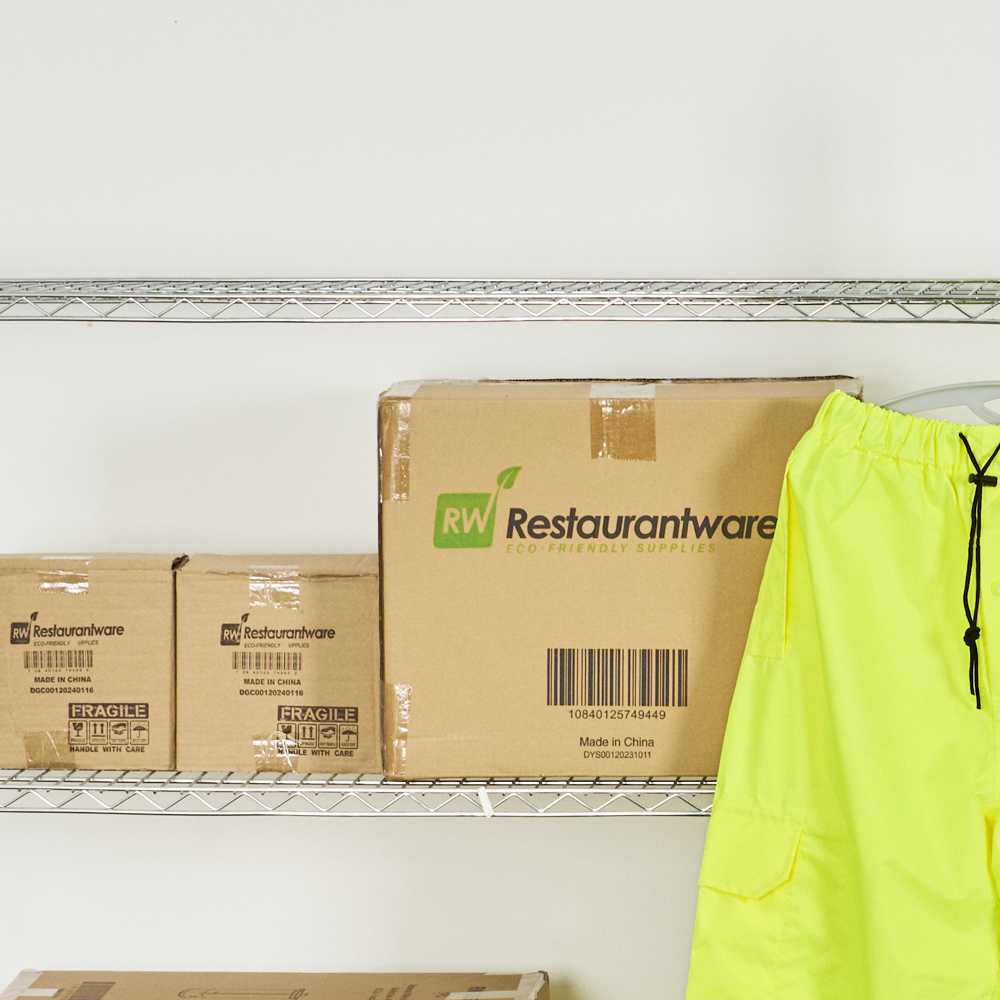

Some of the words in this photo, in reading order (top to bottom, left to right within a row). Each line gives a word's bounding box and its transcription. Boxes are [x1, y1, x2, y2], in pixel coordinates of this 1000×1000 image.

[442, 507, 489, 535] RW
[506, 507, 778, 540] Restaurantware
[637, 543, 716, 553] SUPPLIES
[12, 627, 29, 640] RW
[33, 623, 124, 638] Restaurantware
[223, 629, 239, 640] RW
[244, 626, 336, 639] Restaurantware
[71, 704, 147, 717] FRAGILE
[281, 706, 356, 721] FRAGILE
[569, 709, 666, 720] 10840125749449
[579, 737, 609, 747] Made
[612, 737, 621, 747] in
[624, 737, 654, 747] China
[584, 751, 651, 759] DYS00120231011
